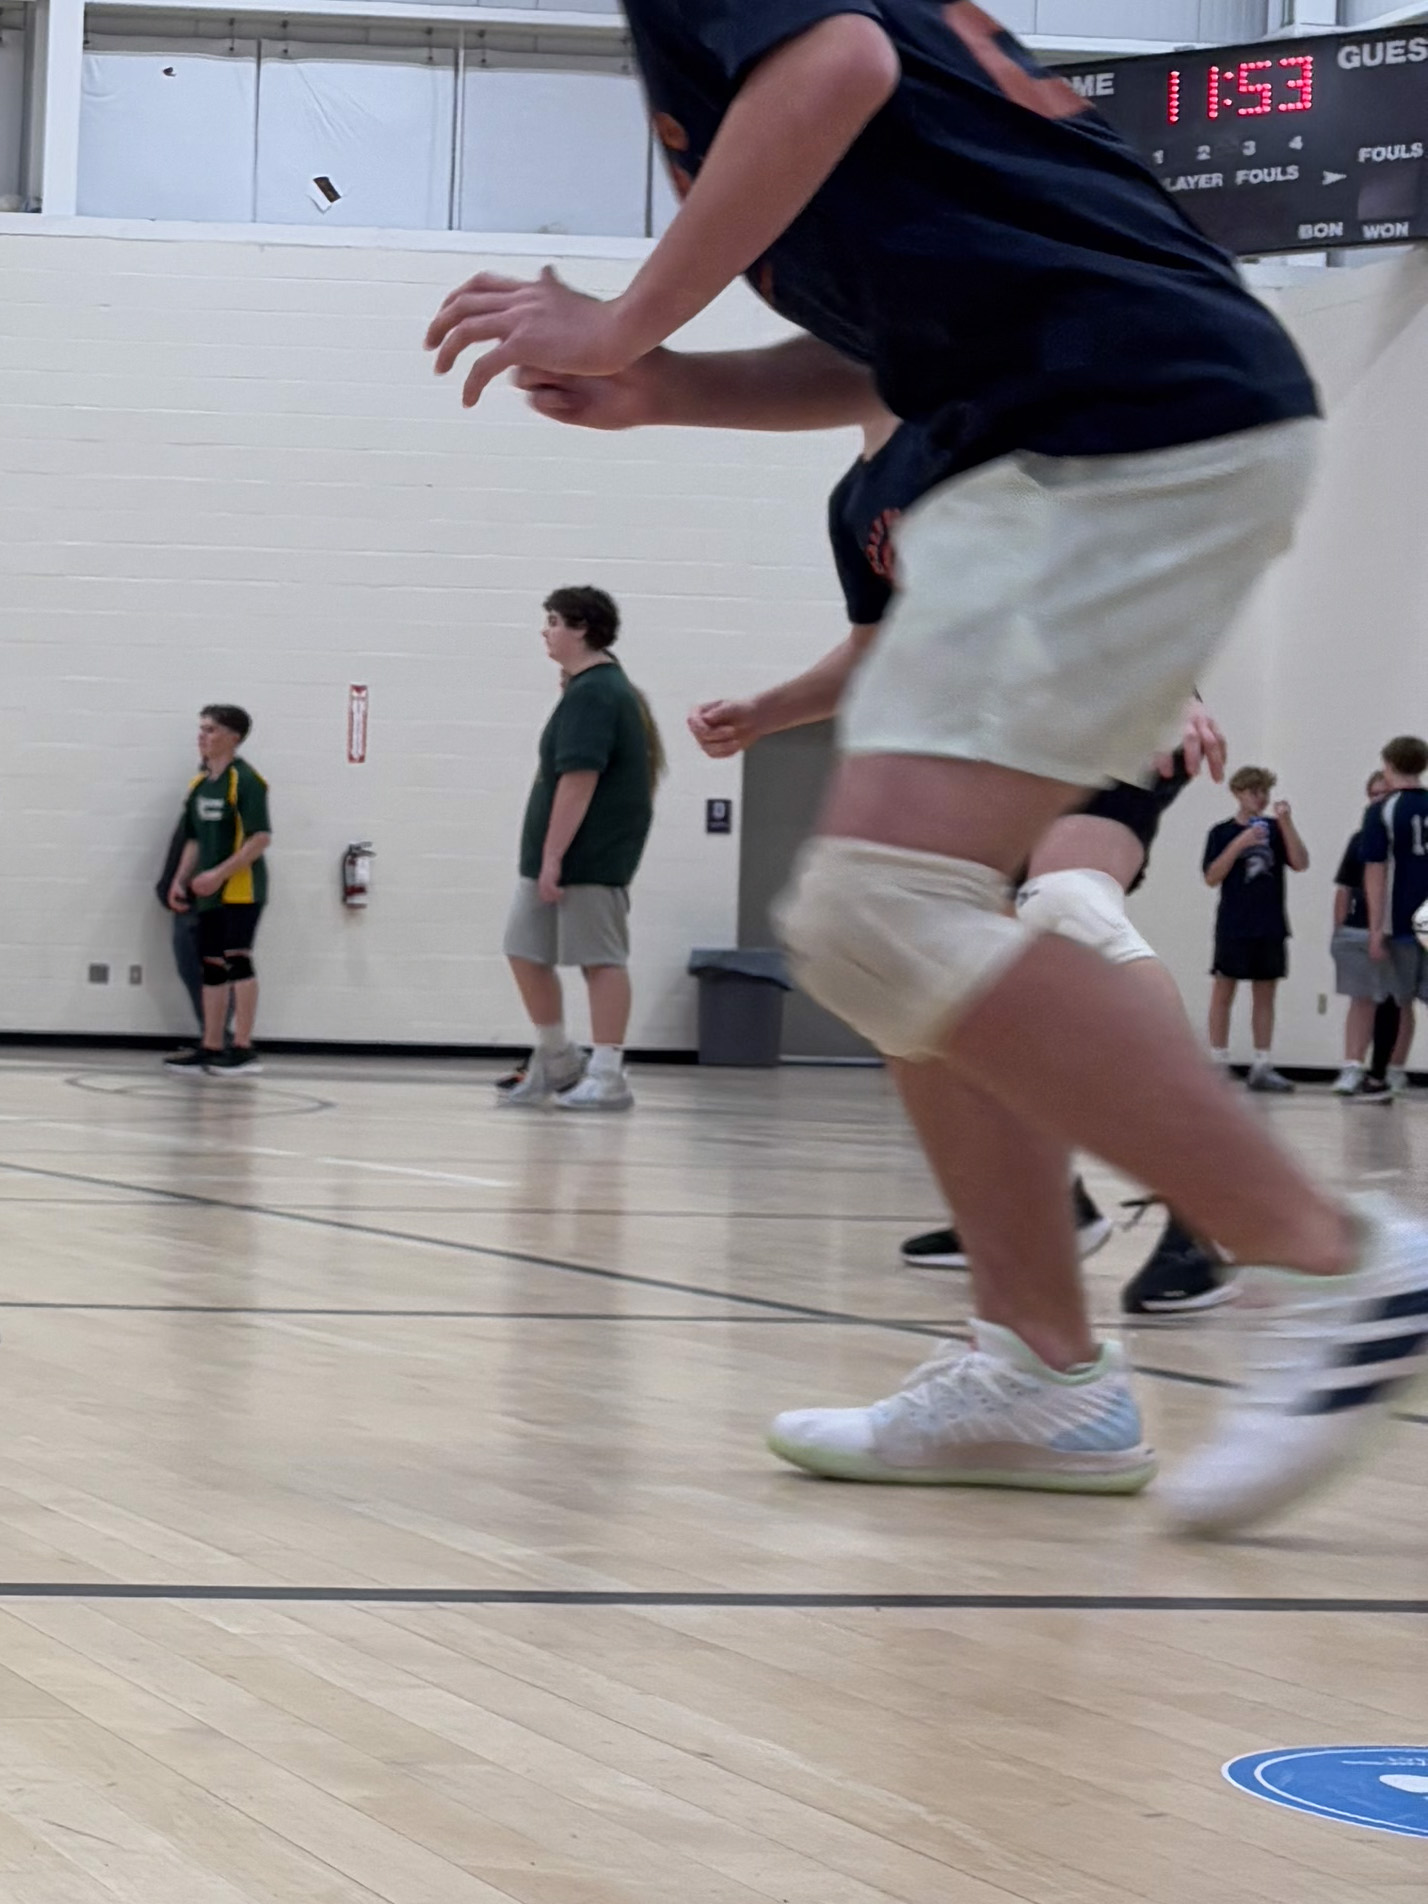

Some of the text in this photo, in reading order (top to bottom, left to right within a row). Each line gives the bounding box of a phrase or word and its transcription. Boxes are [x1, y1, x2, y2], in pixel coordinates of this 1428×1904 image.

[1062, 72, 1115, 97] ME
[1167, 55, 1314, 125] 11:53
[1153, 136, 1303, 164] 1 2 3 4
[1358, 142, 1424, 163] FOULS
[1162, 165, 1300, 192] LAYER FOULS
[1298, 221, 1409, 239] BON WON
[1411, 814, 1428, 856] 1
